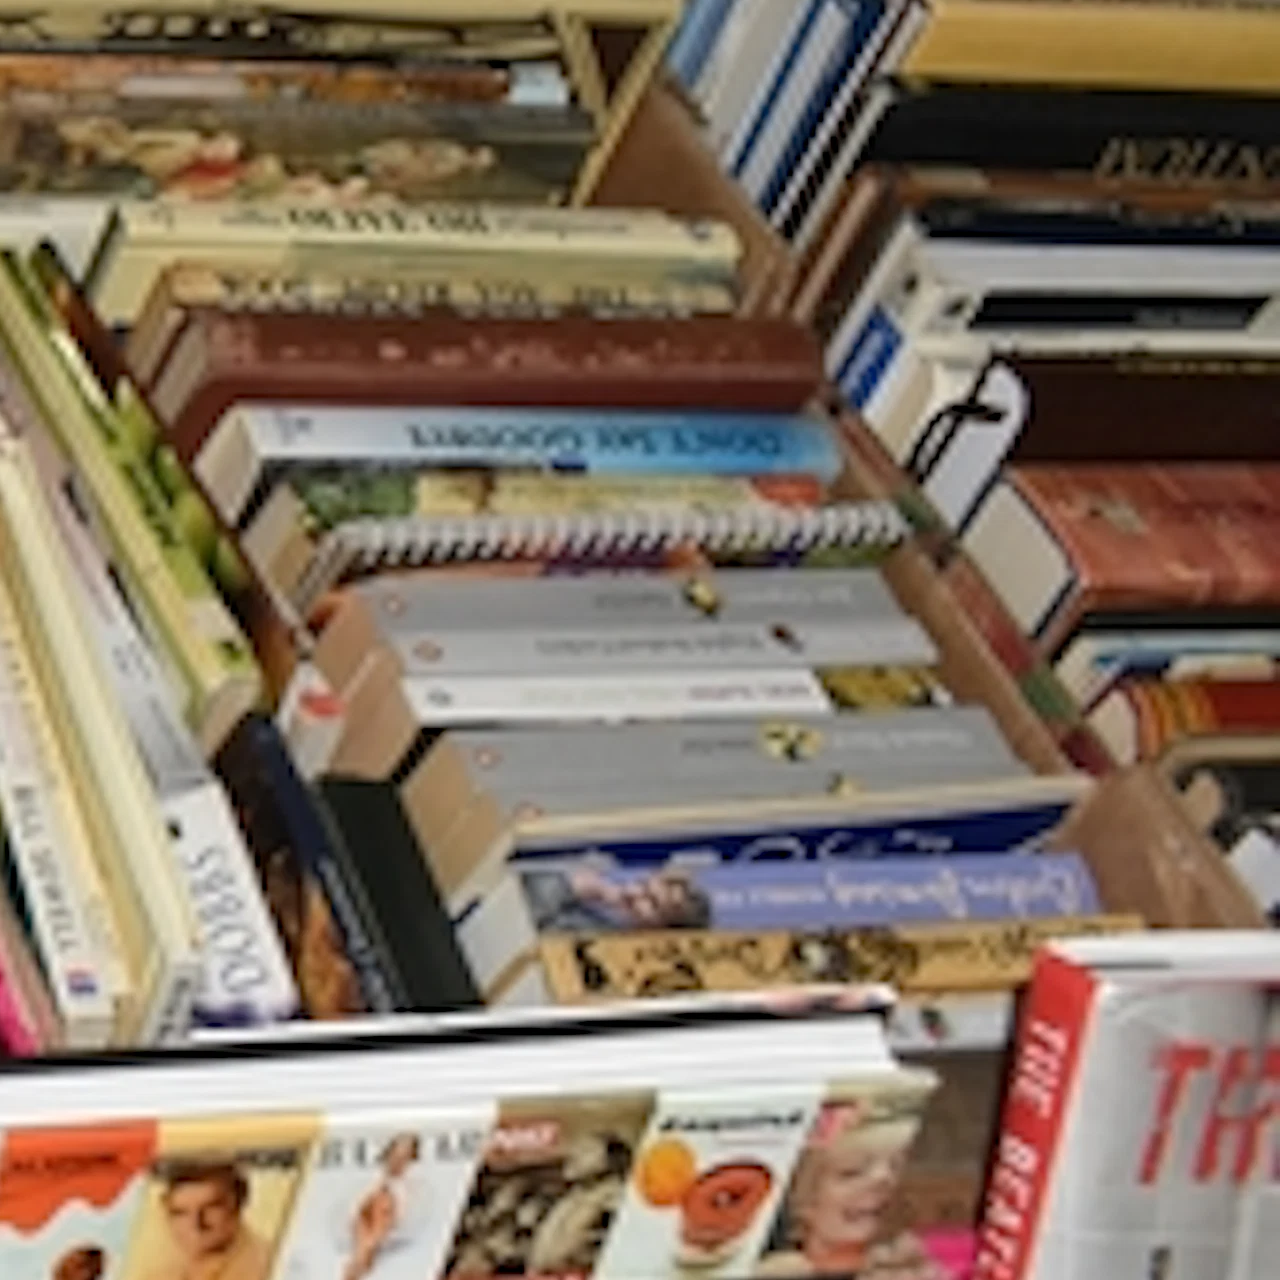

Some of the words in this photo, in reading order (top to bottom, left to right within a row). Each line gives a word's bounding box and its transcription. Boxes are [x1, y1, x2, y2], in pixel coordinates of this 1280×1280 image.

[187, 842, 270, 996] DOBBS
[1008, 1020, 1068, 1106] THE
[1136, 1040, 1280, 1188] TH
